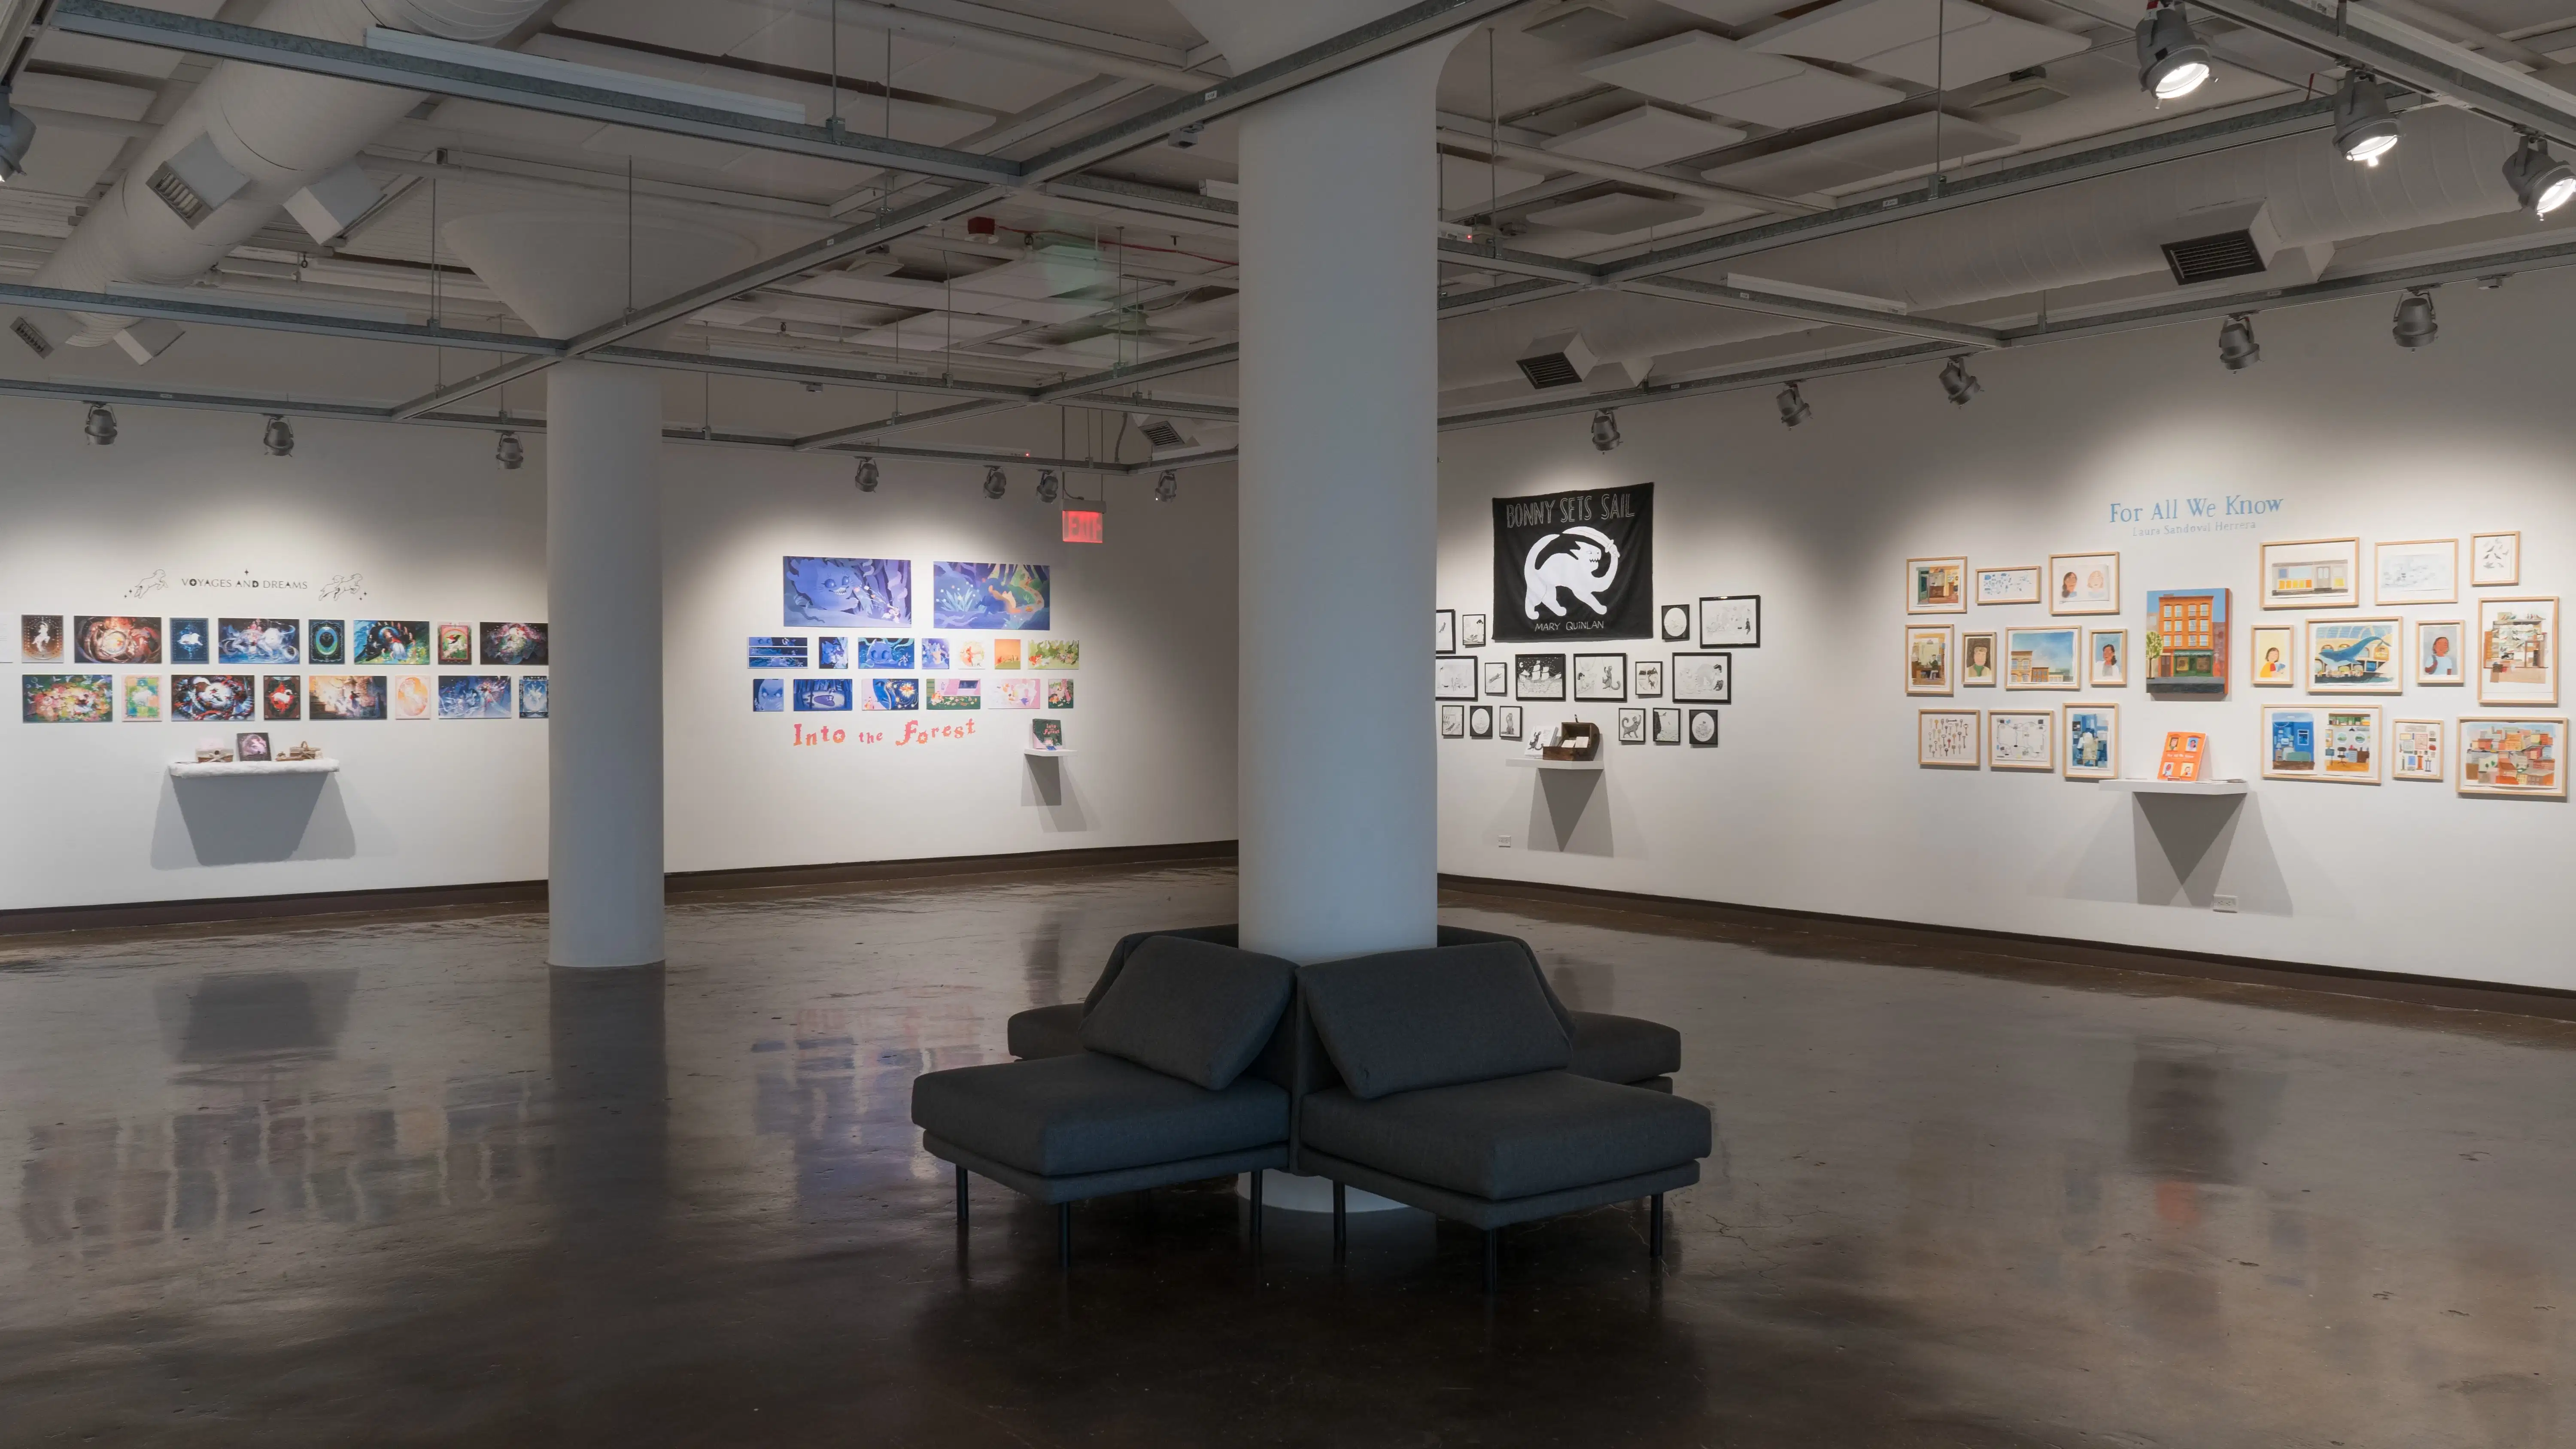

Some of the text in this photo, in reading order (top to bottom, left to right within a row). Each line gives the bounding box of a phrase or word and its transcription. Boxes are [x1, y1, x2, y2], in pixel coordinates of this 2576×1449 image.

[1506, 493, 1635, 528] BONNY SETS SAIL
[2109, 494, 2284, 524] For All We Know
[2132, 521, 2257, 537] Laura Sandoval Herrera
[181, 578, 308, 589] VOYAGES AND DREAMS
[1534, 622, 1561, 632] MARY
[793, 718, 976, 747] Into the Forest
